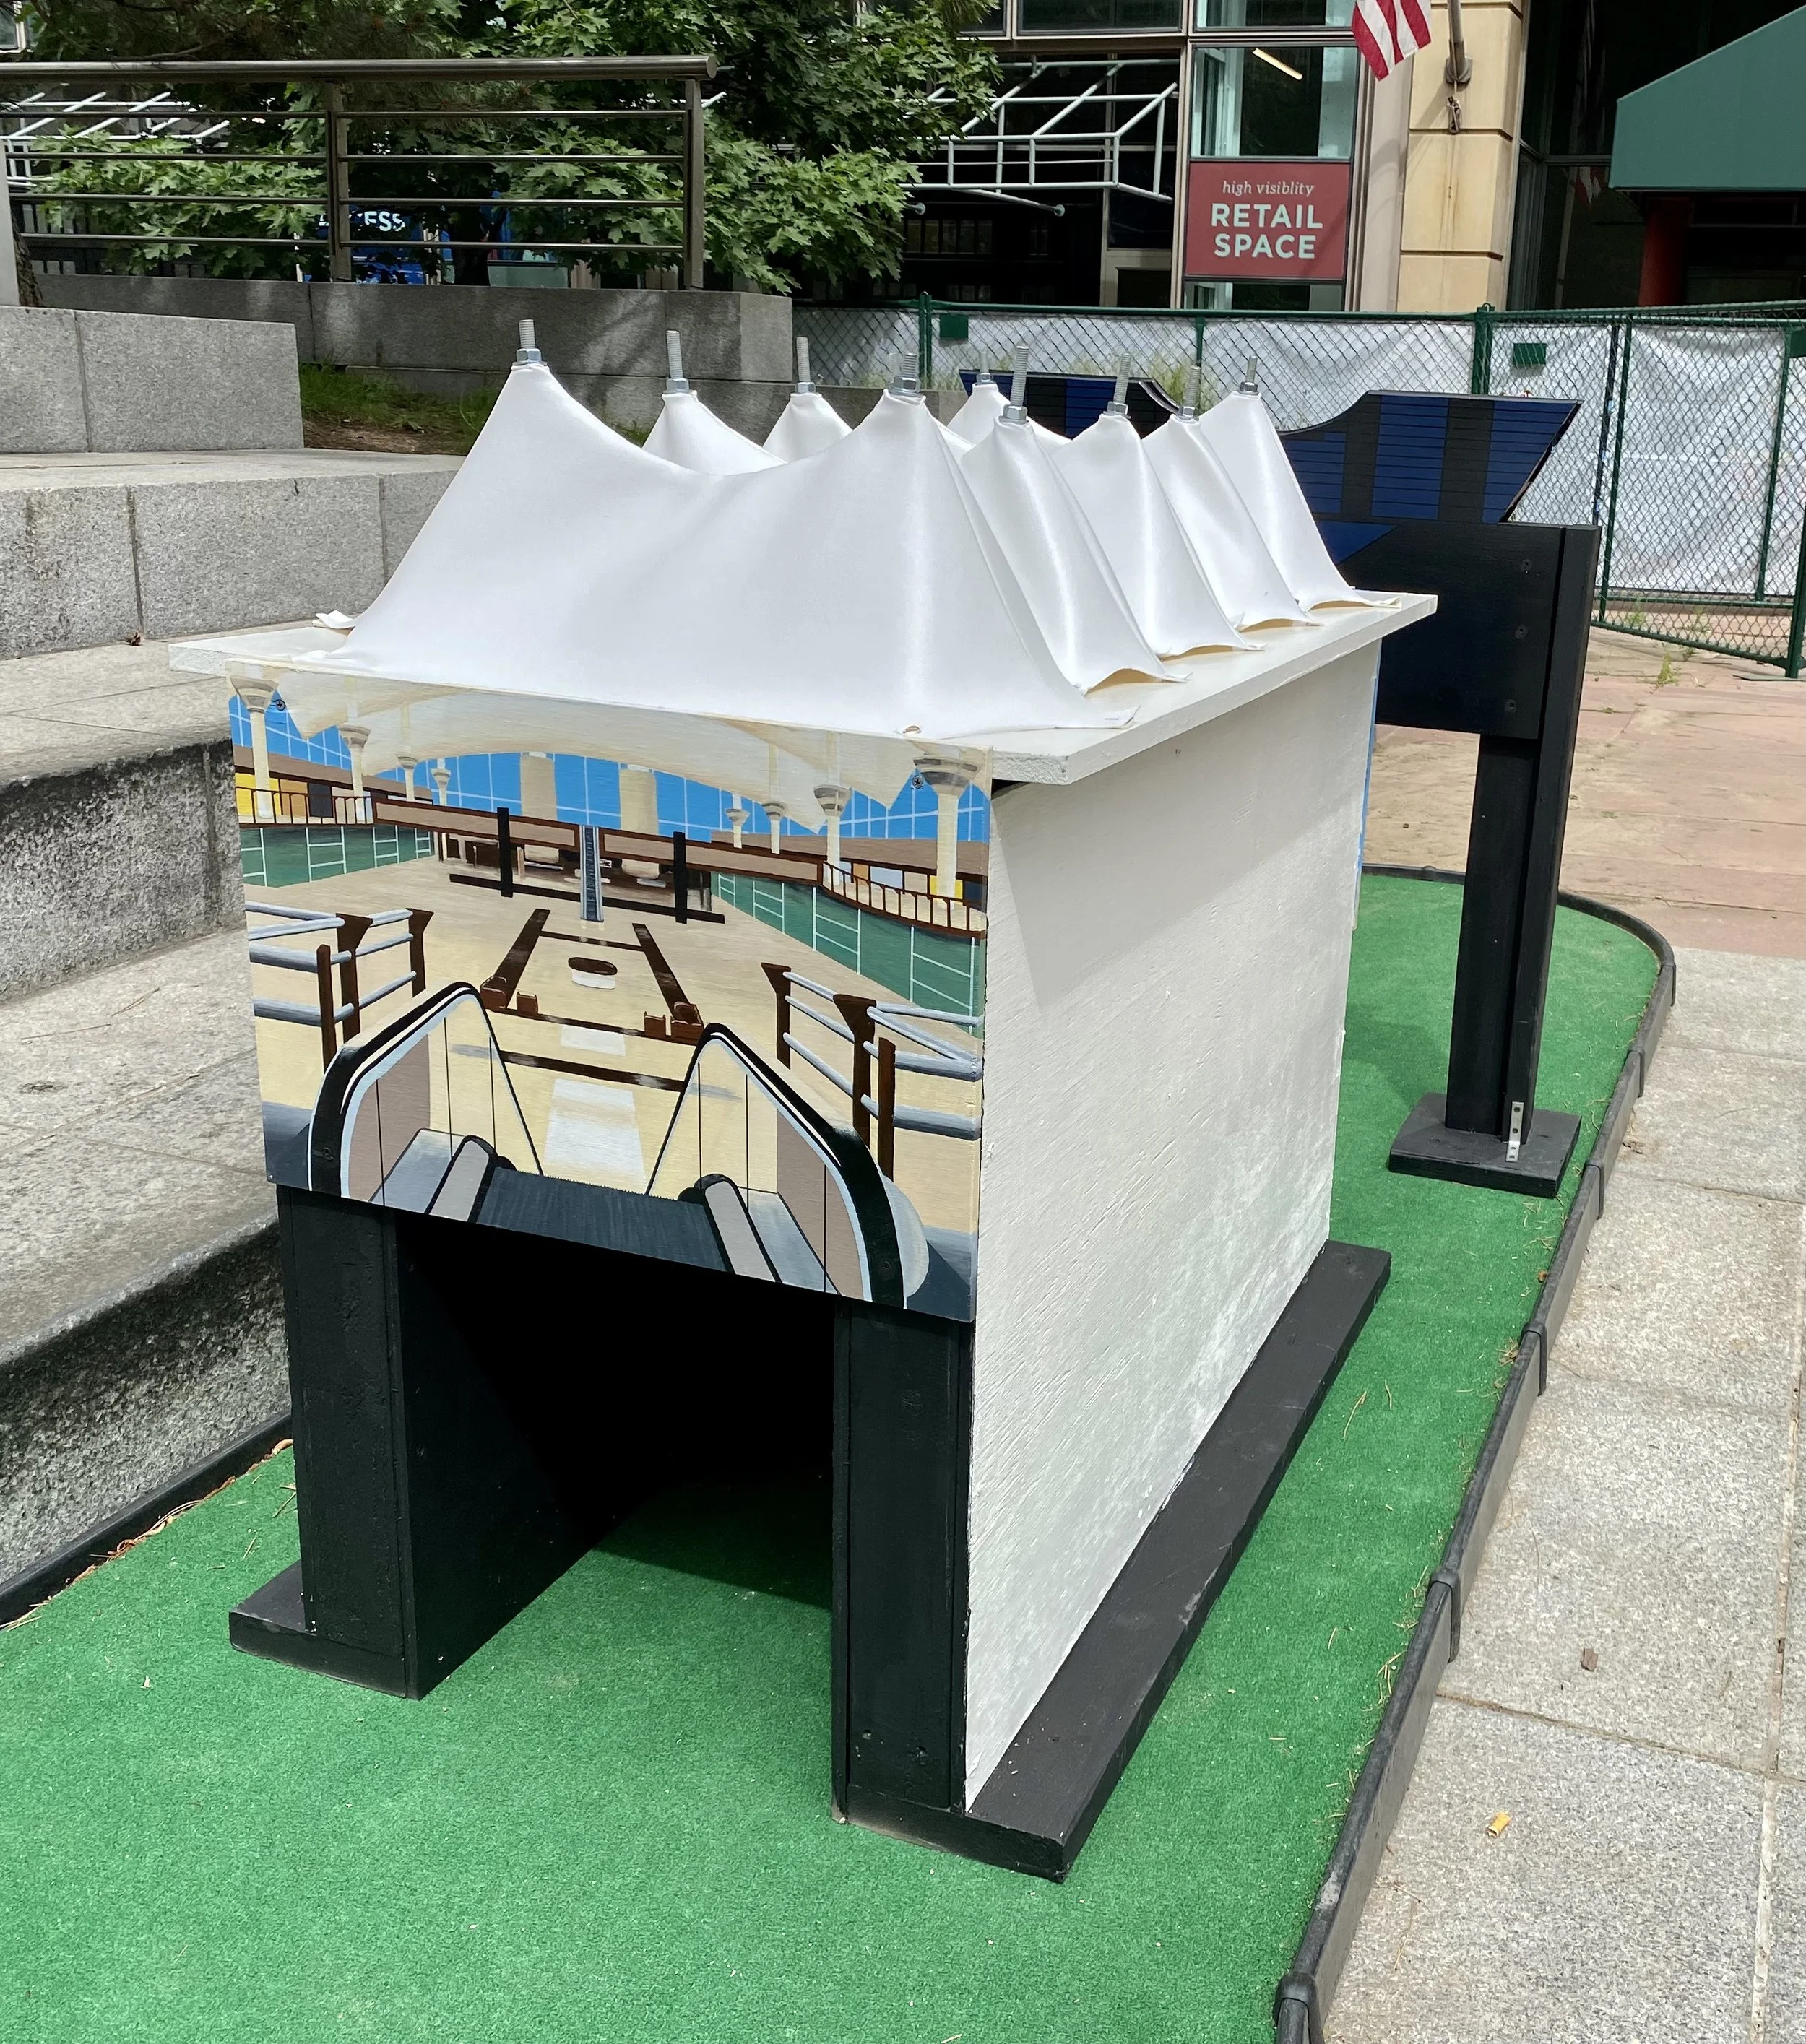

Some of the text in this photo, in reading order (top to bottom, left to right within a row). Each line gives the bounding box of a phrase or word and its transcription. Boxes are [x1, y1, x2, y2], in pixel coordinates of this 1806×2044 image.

[1222, 181, 1315, 197] high visiblity
[1211, 203, 1323, 229] RETAIL
[1214, 233, 1316, 259] SPACE
